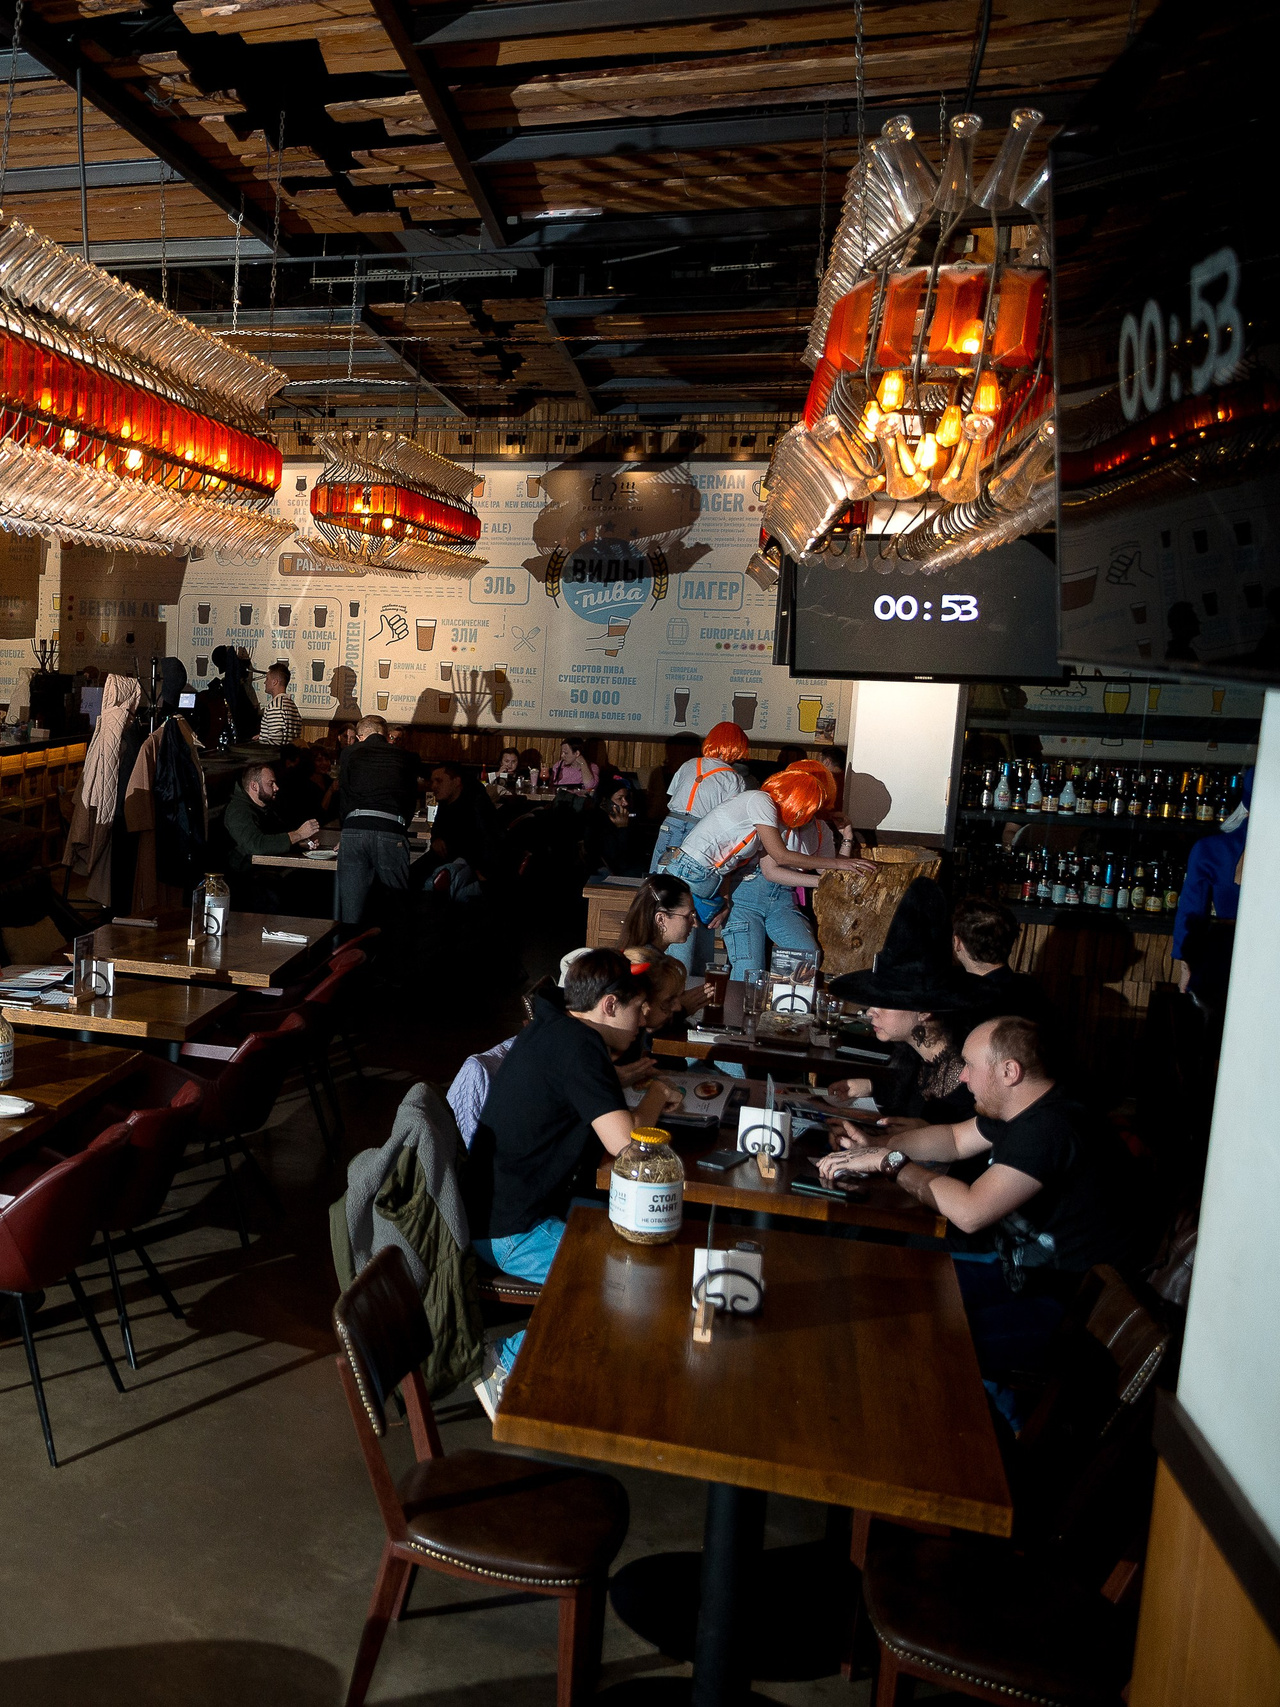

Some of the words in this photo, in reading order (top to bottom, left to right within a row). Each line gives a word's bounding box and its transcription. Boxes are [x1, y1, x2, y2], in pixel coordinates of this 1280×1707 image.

[1119, 246, 1245, 422] 00:53
[691, 475, 745, 489] GERMAN
[288, 499, 309, 509] SCOTC
[689, 493, 744, 512] LAGER
[572, 559, 645, 587] ВИДЫ
[484, 576, 516, 595] ЭЛЬ
[682, 580, 740, 601] ЛАГЕР
[582, 580, 644, 608] пива
[79, 600, 136, 617] BELGIAN
[141, 602, 166, 618] ALE
[873, 594, 979, 621] 00:53
[441, 619, 490, 627] КЛАССИЧЕСКИЕ
[193, 627, 213, 636] IRISH
[225, 628, 264, 638] AMERICAN
[271, 629, 296, 639] SWEET
[302, 630, 337, 640] OATMEAL
[451, 628, 478, 643] ЭЛИ
[700, 627, 754, 641] EUROPEAN
[192, 637, 214, 646] STOUT
[271, 640, 295, 649] STOUT
[307, 641, 331, 651] STOUT
[0, 649, 25, 658] GUEUZE
[393, 662, 414, 670] BROWN
[416, 663, 426, 671] ALE
[509, 666, 524, 674] MILD
[526, 667, 537, 675] ALE
[571, 664, 601, 674] СОРТОВ
[603, 665, 624, 675] ПИВА
[558, 674, 609, 685] СУЩЕСТВУЕТ
[612, 676, 637, 685] БОЛЕЕ
[303, 683, 330, 693] BALTIC
[302, 694, 331, 704] PORTER
[391, 694, 416, 702] PUMPKIN
[570, 688, 588, 704] 50
[592, 689, 620, 705] 000
[524, 701, 536, 709] ALE
[549, 708, 577, 718] СТИЛЕЙ
[579, 710, 599, 719] ПИВА
[601, 711, 625, 720] БОЛЕЕ
[652, 1193, 677, 1203] СТОЛ
[648, 1202, 678, 1213] ЗАНЯТ
